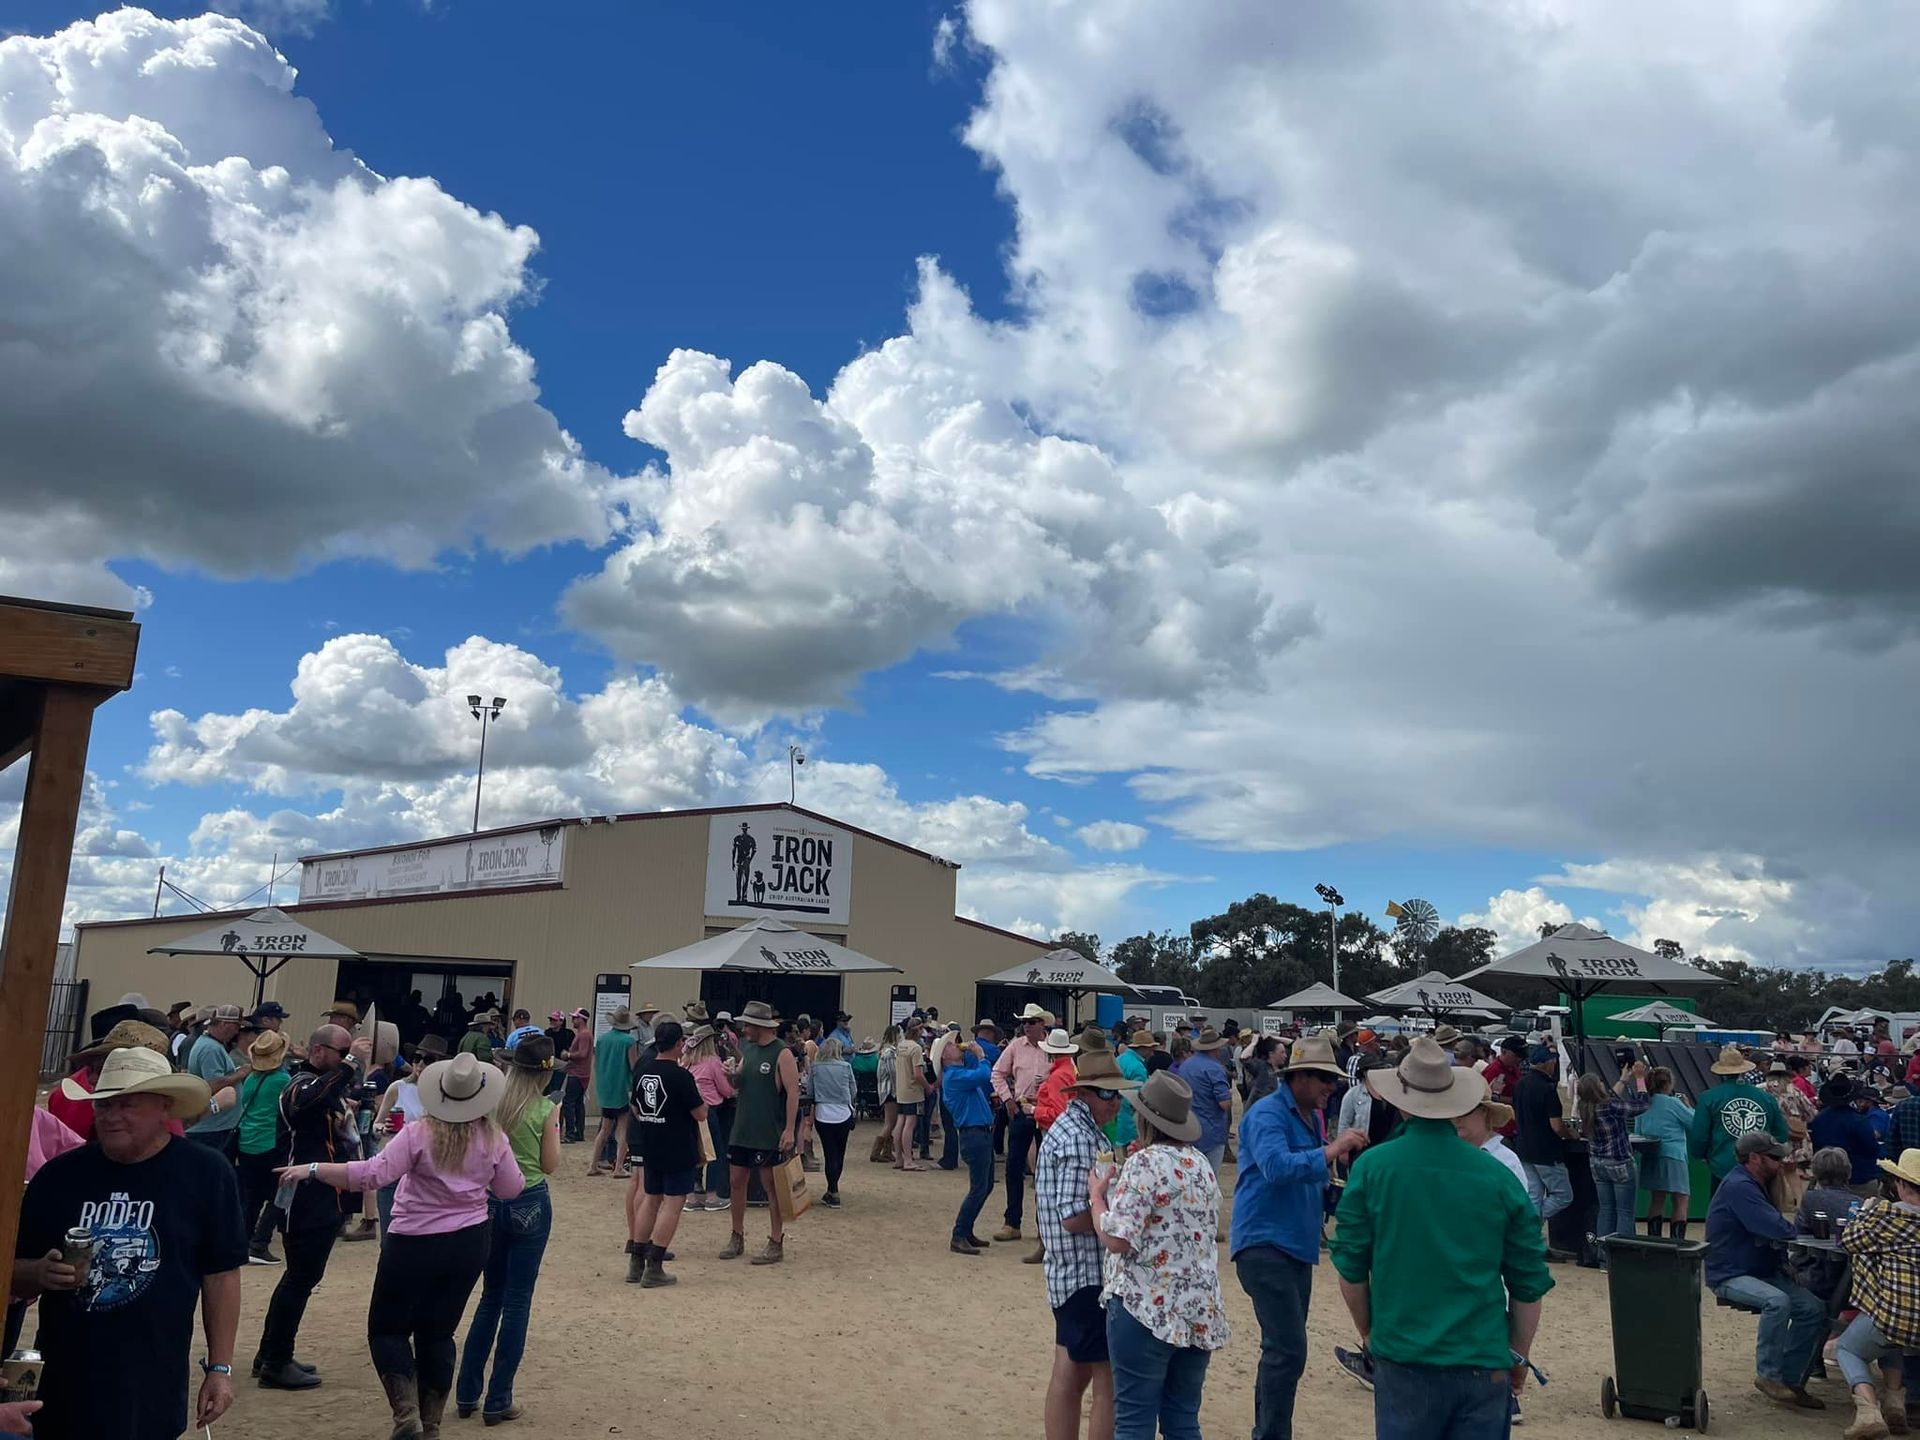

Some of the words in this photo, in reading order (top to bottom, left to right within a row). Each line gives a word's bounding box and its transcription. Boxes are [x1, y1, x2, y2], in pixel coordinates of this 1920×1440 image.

[771, 834, 833, 867] IRON
[478, 850, 502, 871] IRON
[502, 847, 529, 869] JACK
[324, 870, 341, 888] IRON
[767, 863, 831, 896] JACK
[254, 934, 307, 944] IRON
[250, 942, 304, 951] JACK
[782, 949, 829, 960] IRON
[792, 959, 837, 968] JACK
[1578, 957, 1639, 969] IRON
[1584, 967, 1645, 977] JACK
[1437, 991, 1472, 1000] IRON
[1440, 998, 1475, 1006] JACK
[110, 1192, 130, 1201] ISA
[79, 1200, 154, 1231] RODEO
